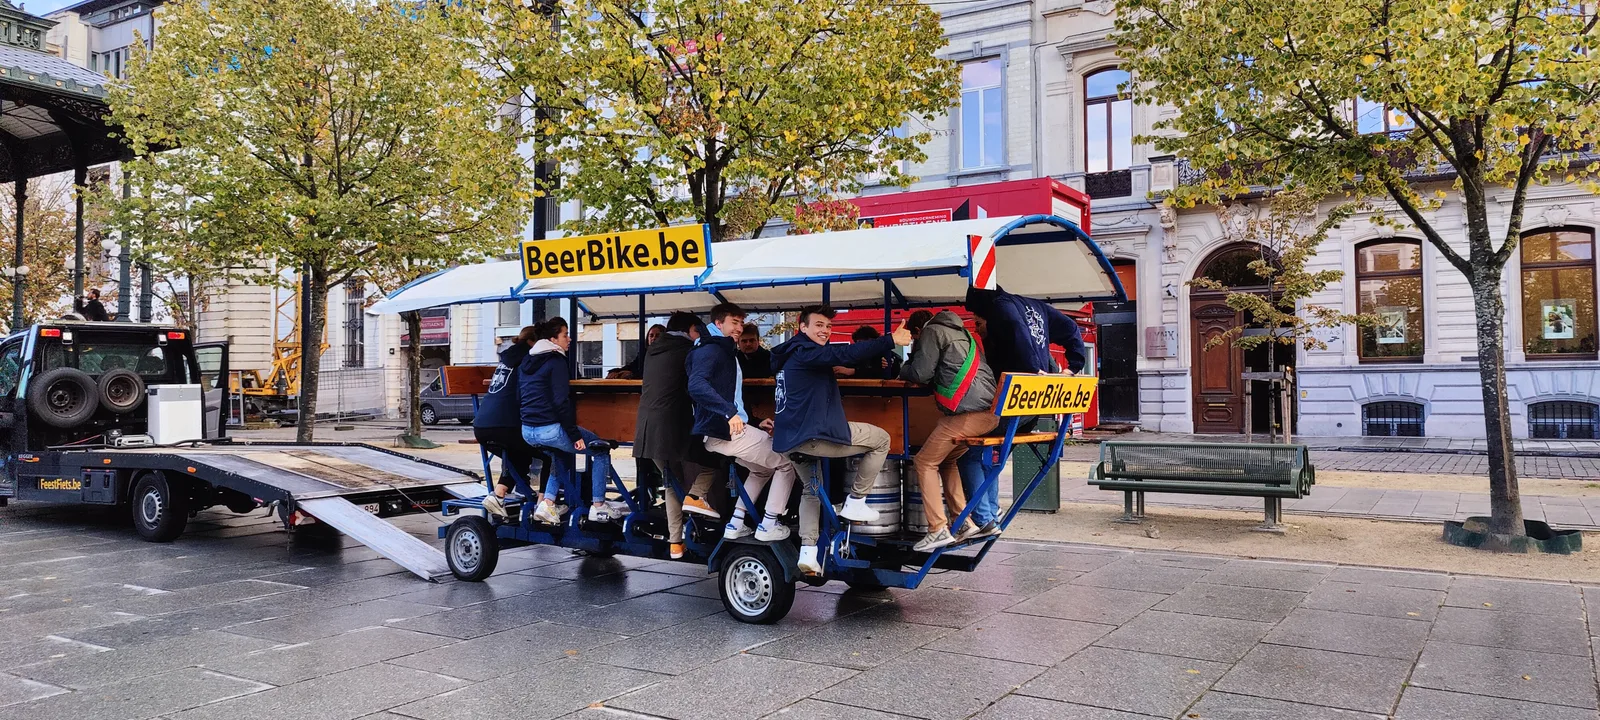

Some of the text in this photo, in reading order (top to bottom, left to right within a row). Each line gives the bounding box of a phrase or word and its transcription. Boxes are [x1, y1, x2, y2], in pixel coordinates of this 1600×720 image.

[526, 232, 699, 276] BeerBike.be
[1163, 378, 1176, 388] 26
[1007, 383, 1091, 410] BeerBike.be
[40, 478, 81, 490] FeestFiets.be
